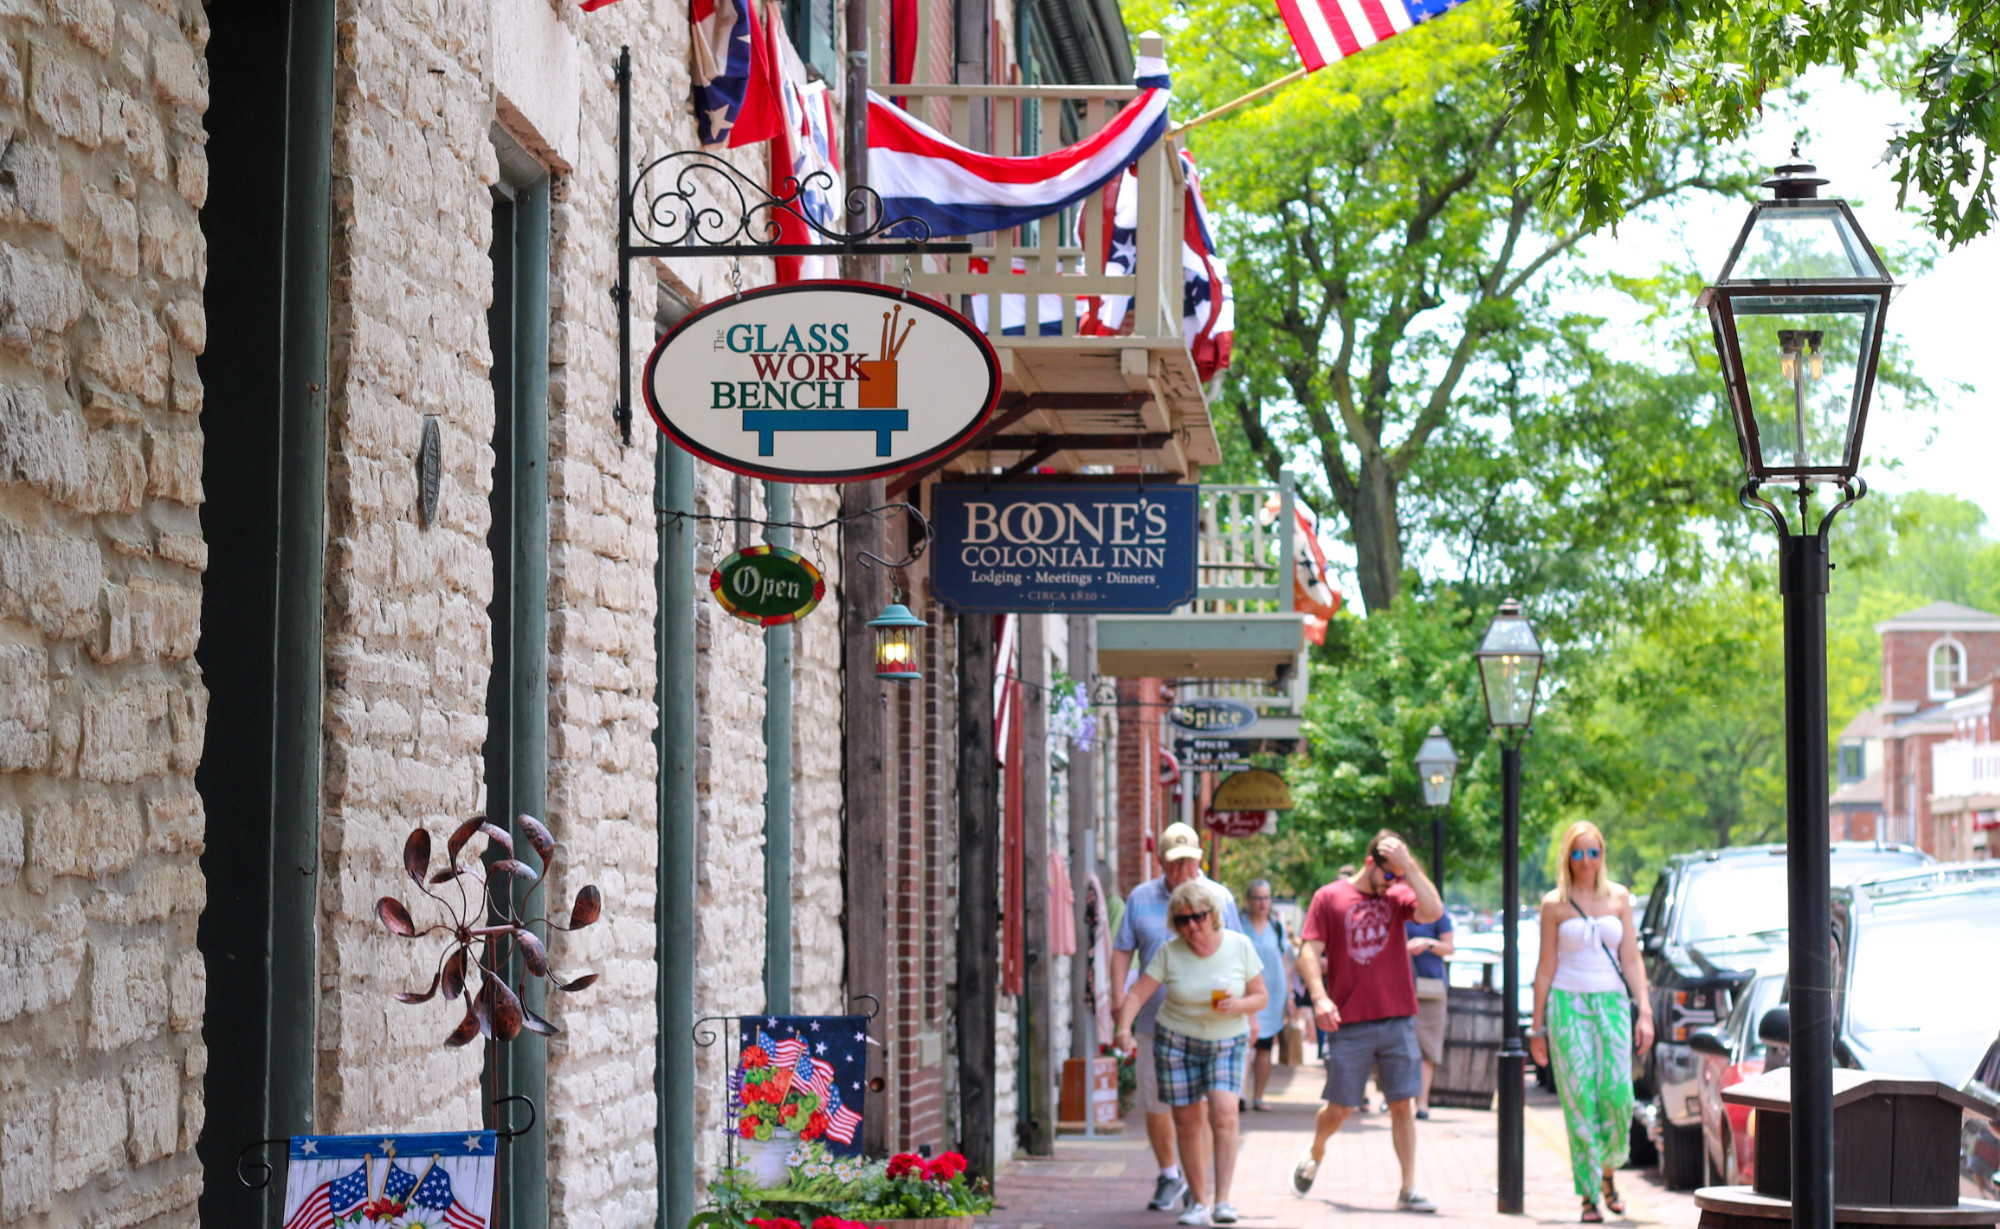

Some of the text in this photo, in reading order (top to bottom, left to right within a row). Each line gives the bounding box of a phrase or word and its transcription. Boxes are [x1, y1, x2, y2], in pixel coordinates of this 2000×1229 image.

[713, 328, 725, 352] The
[726, 323, 850, 353] GLASS
[749, 353, 872, 381] WORK
[710, 381, 845, 410] BENCH
[961, 497, 1167, 545] BOONE'S
[961, 546, 1166, 569] COLONIAL INN
[732, 565, 800, 605] Open
[971, 570, 1156, 587] Lodging Meetings Dinners
[1027, 590, 1098, 601] CIRCA 1820
[1181, 707, 1243, 729] Spice
